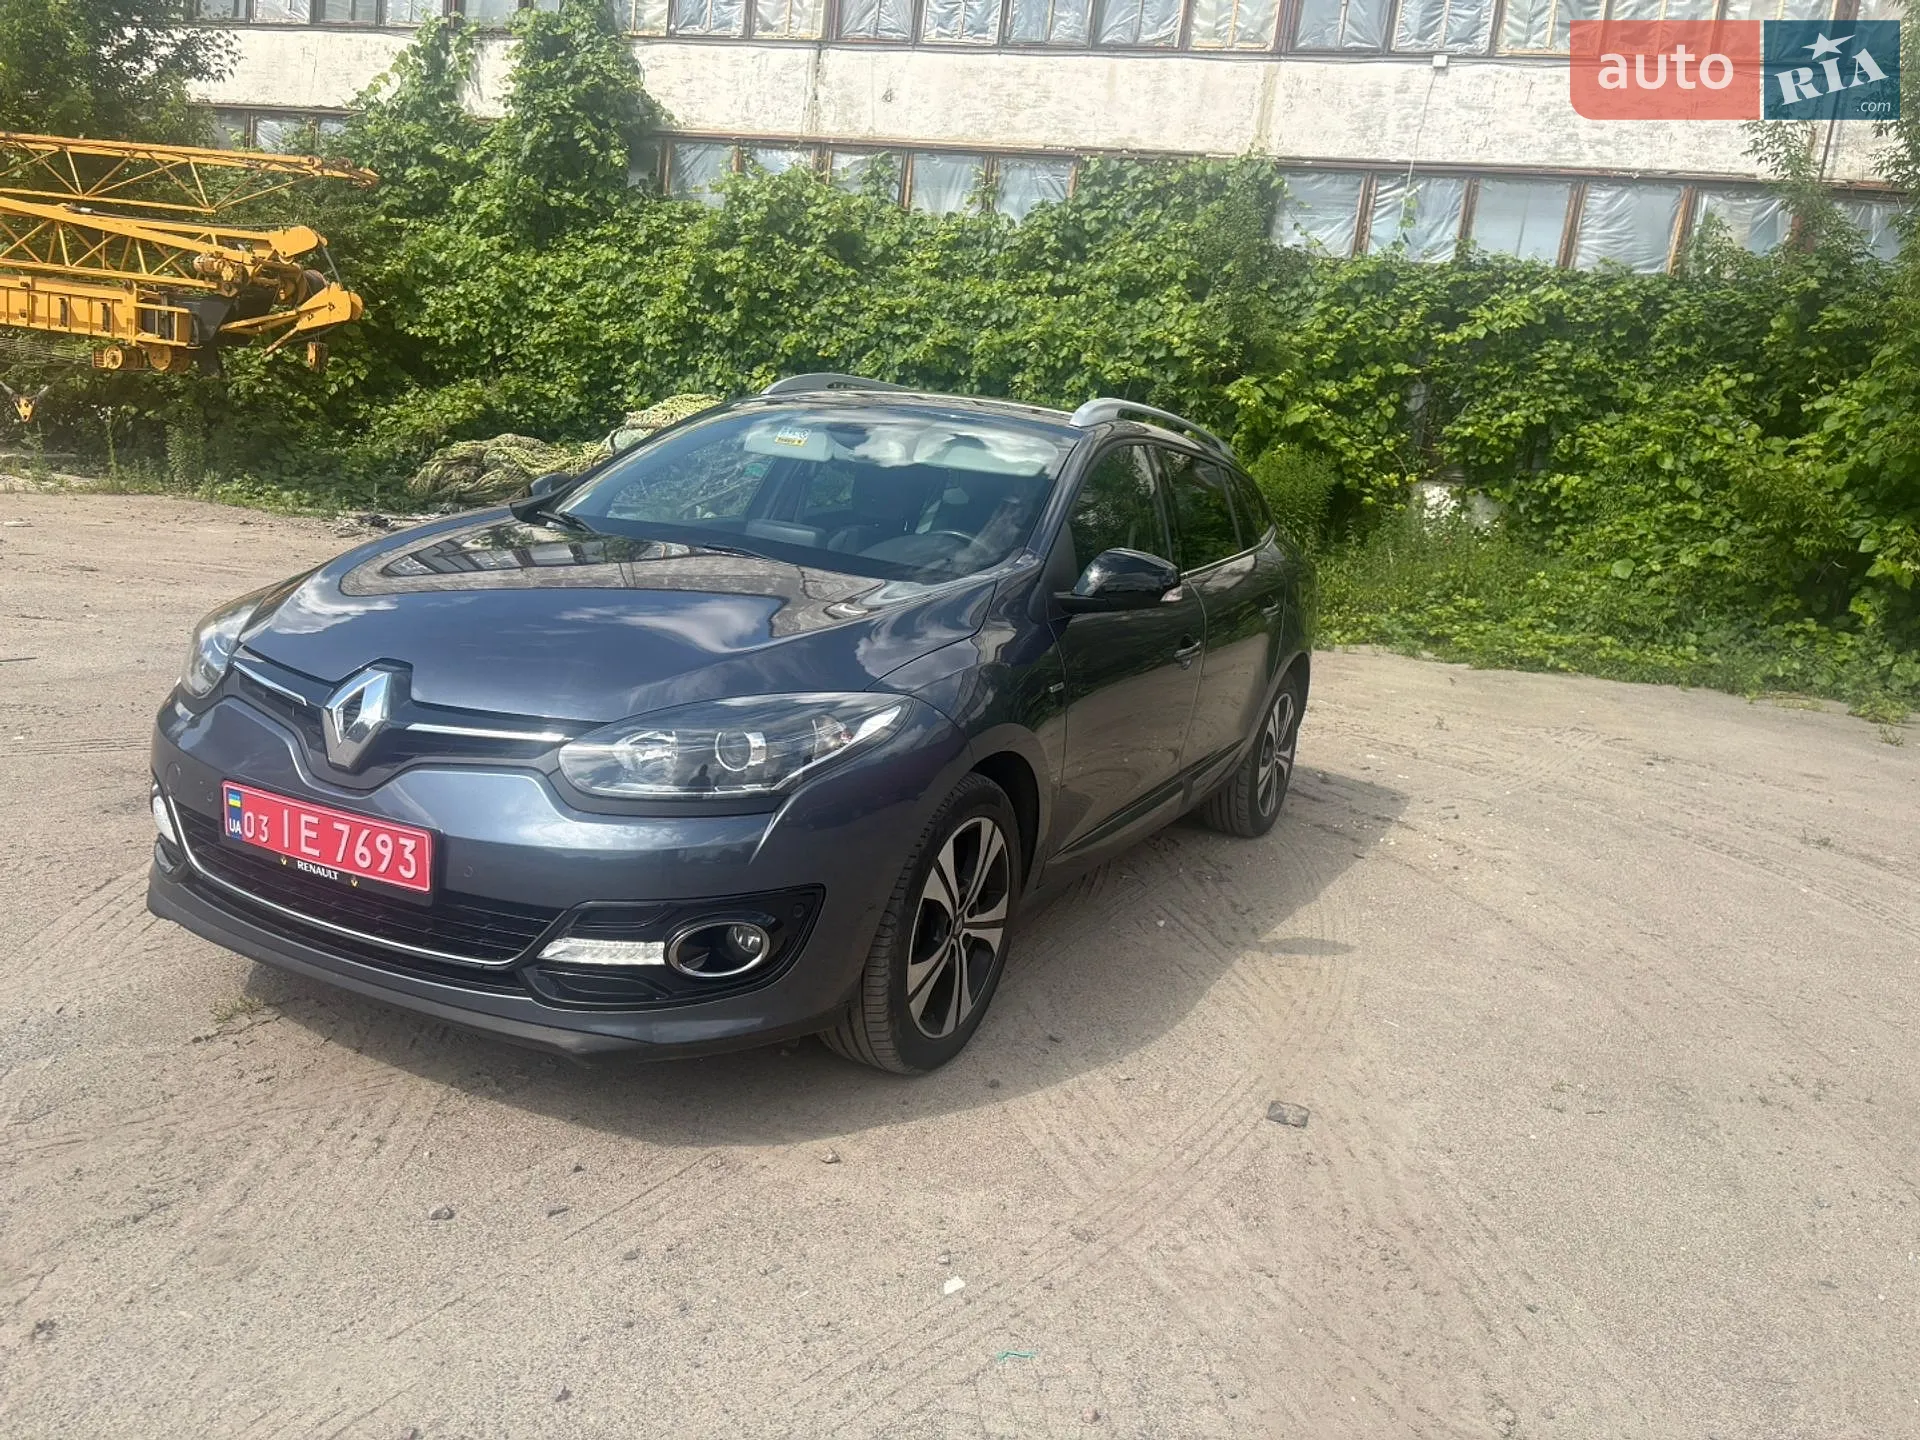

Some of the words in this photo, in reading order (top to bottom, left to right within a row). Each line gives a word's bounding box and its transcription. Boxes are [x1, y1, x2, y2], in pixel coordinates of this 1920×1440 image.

[229, 819, 242, 834] UA
[244, 812, 269, 843] 03
[283, 809, 320, 857] IE
[333, 821, 416, 879] 7693
[297, 860, 339, 880] RENAULT
